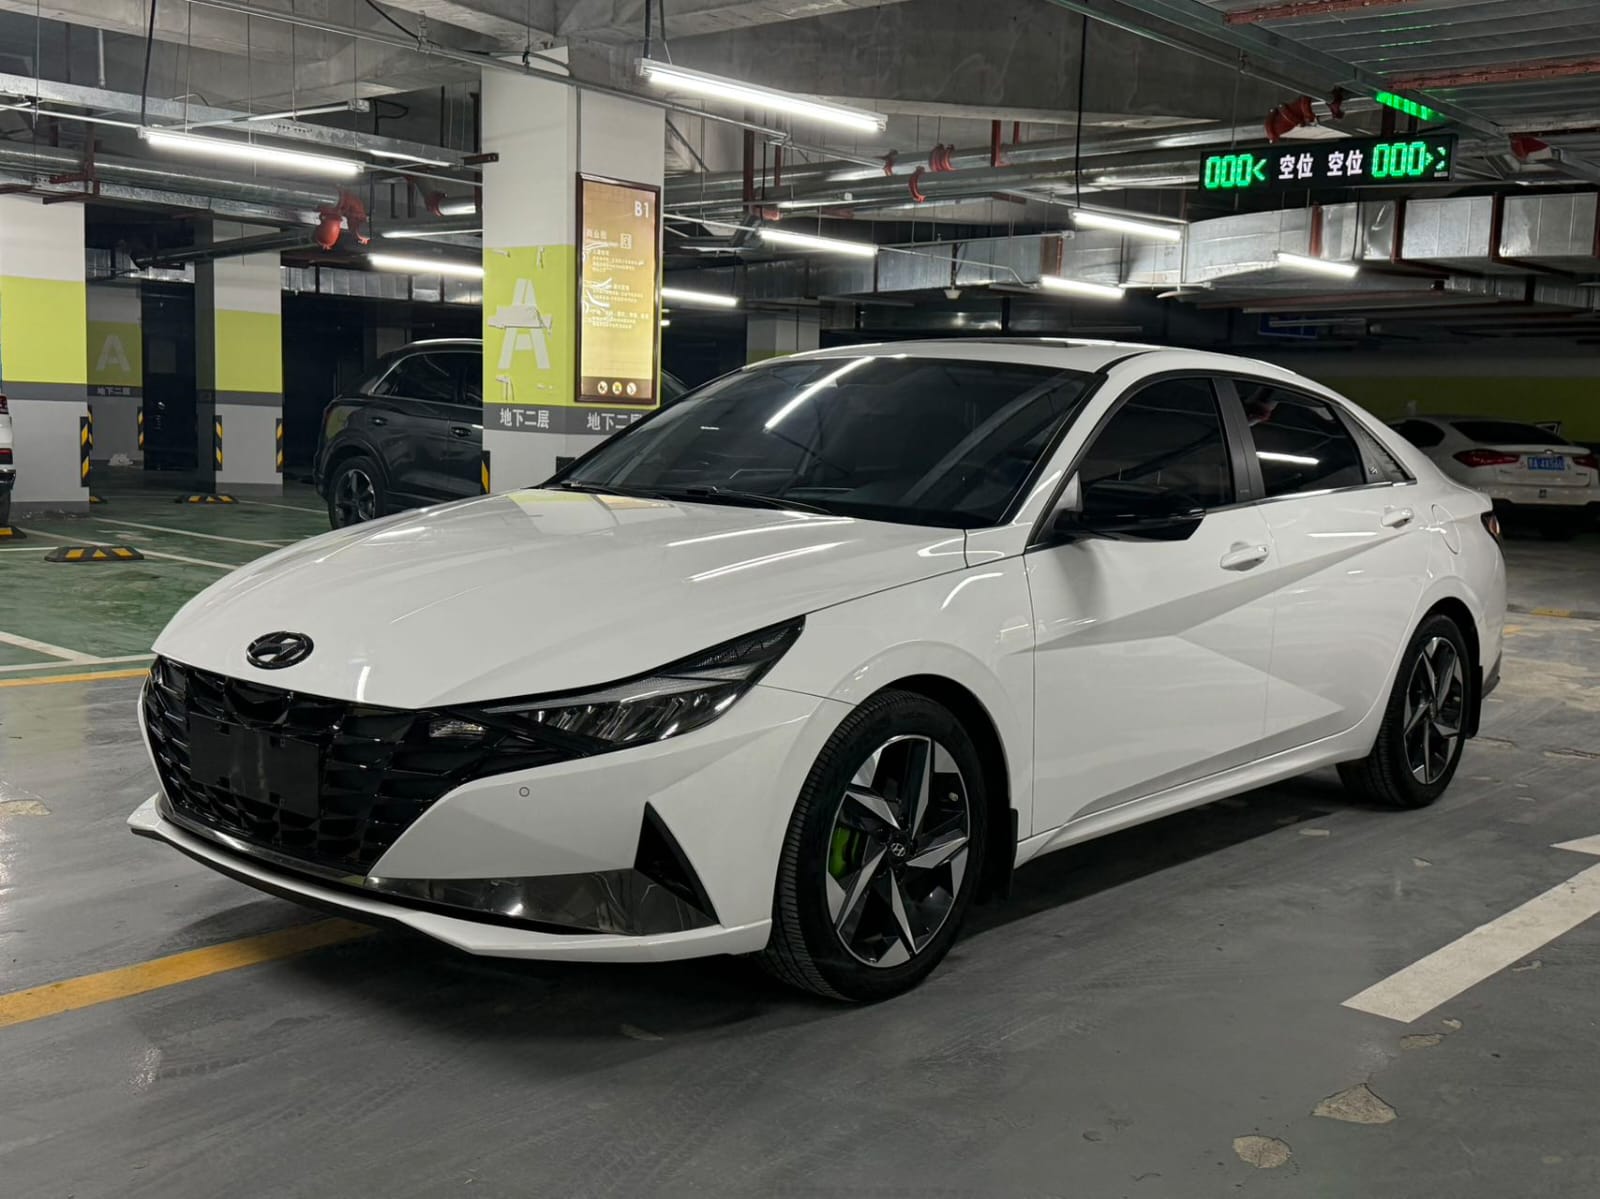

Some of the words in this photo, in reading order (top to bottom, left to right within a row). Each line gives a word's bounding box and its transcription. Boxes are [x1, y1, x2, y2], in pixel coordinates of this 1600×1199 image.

[1204, 154, 1251, 188] 000
[1278, 154, 1314, 180] 空位
[1327, 150, 1363, 177] 空位
[1371, 141, 1426, 178] 000
[634, 201, 649, 218] B1
[498, 278, 551, 370] A
[95, 335, 131, 372] A
[499, 407, 550, 430] 地下二层
